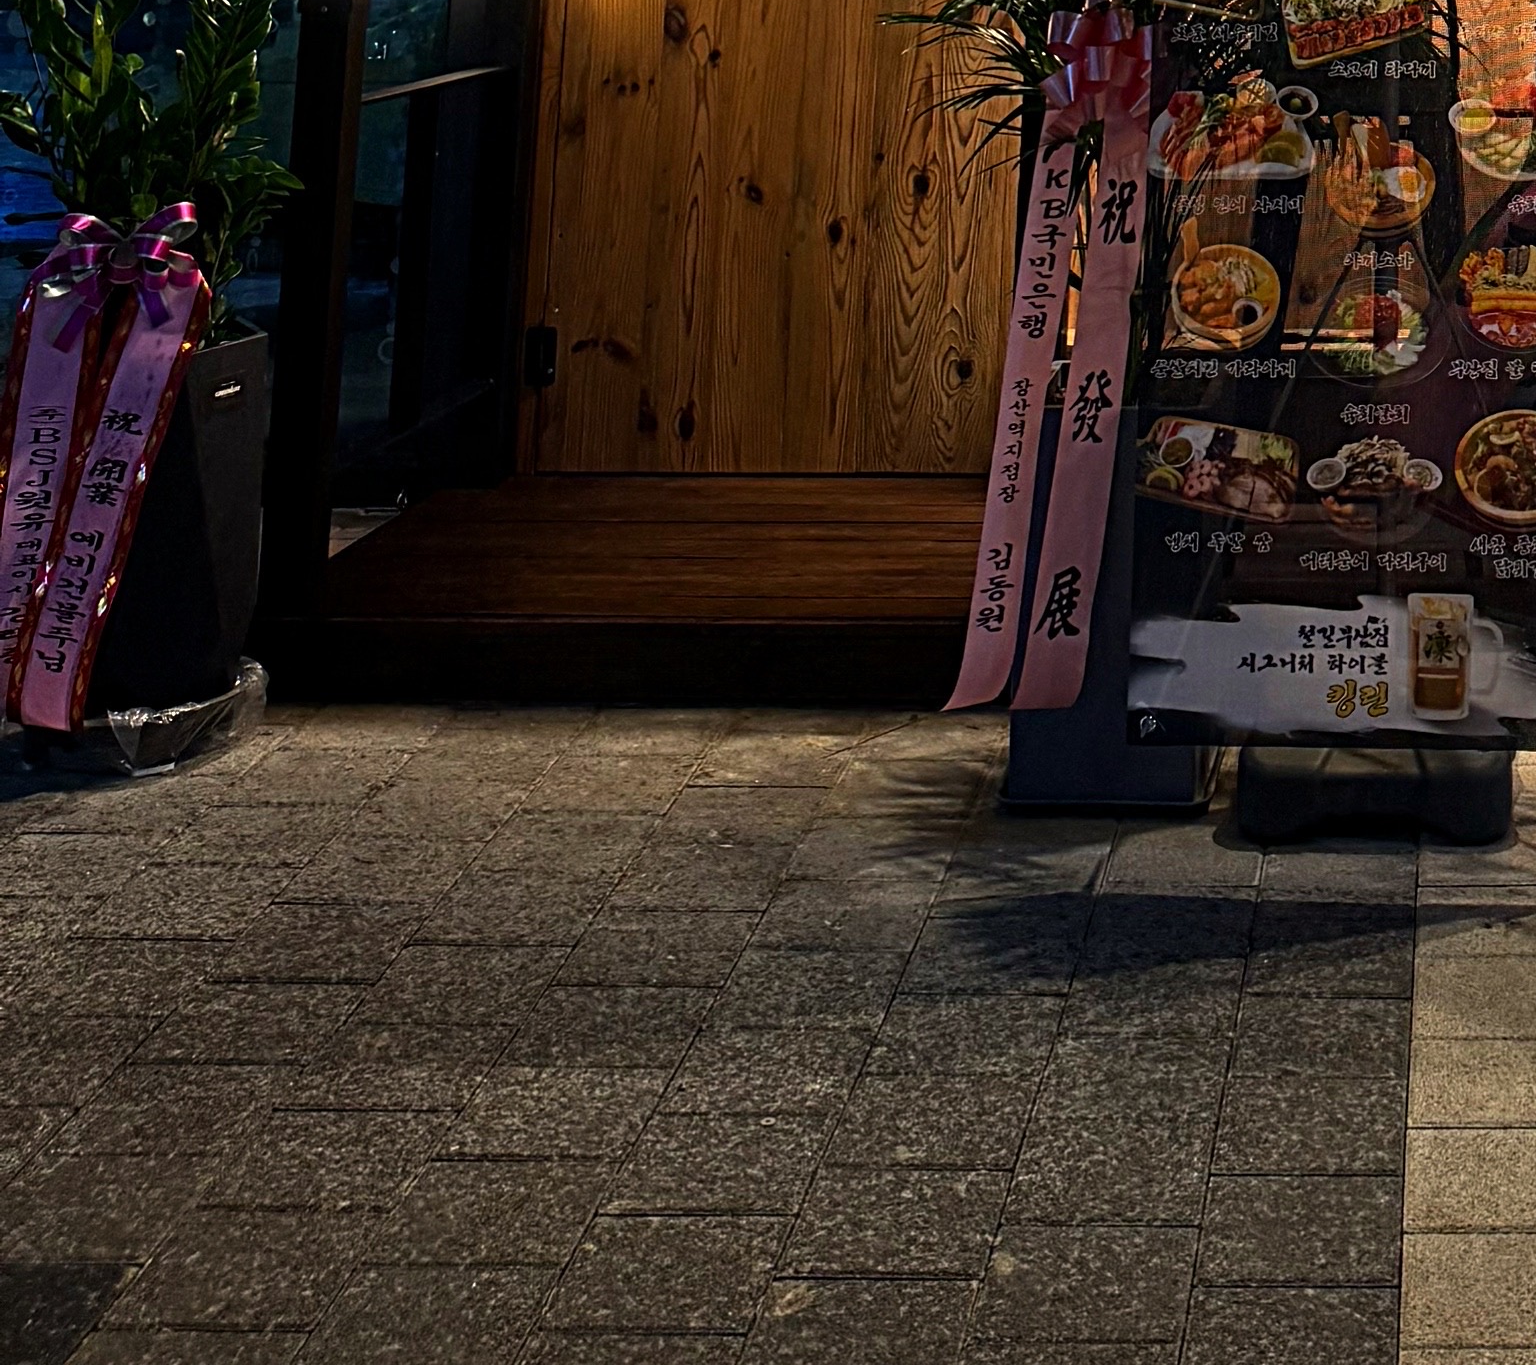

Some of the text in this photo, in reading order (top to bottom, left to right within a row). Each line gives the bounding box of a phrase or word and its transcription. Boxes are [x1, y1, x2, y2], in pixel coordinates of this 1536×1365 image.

[1328, 60, 1438, 80] 소고기 타다끼
[1212, 195, 1247, 216] 연어
[1252, 195, 1305, 216] 사시미
[1343, 251, 1415, 271] 야끼소바
[1449, 358, 1500, 380] 부산집
[976, 169, 1070, 633] KB국민은행 장산역지점장 김동원
[102, 409, 143, 437] 祝
[1165, 532, 1199, 553] 냉채
[1207, 532, 1246, 553] 족발
[1300, 551, 1448, 573] 버터문어 다리구이
[1298, 624, 1389, 649] 철길부산집
[1237, 652, 1389, 675] 시그니처 하이볼
[1326, 679, 1389, 719] 킹린
